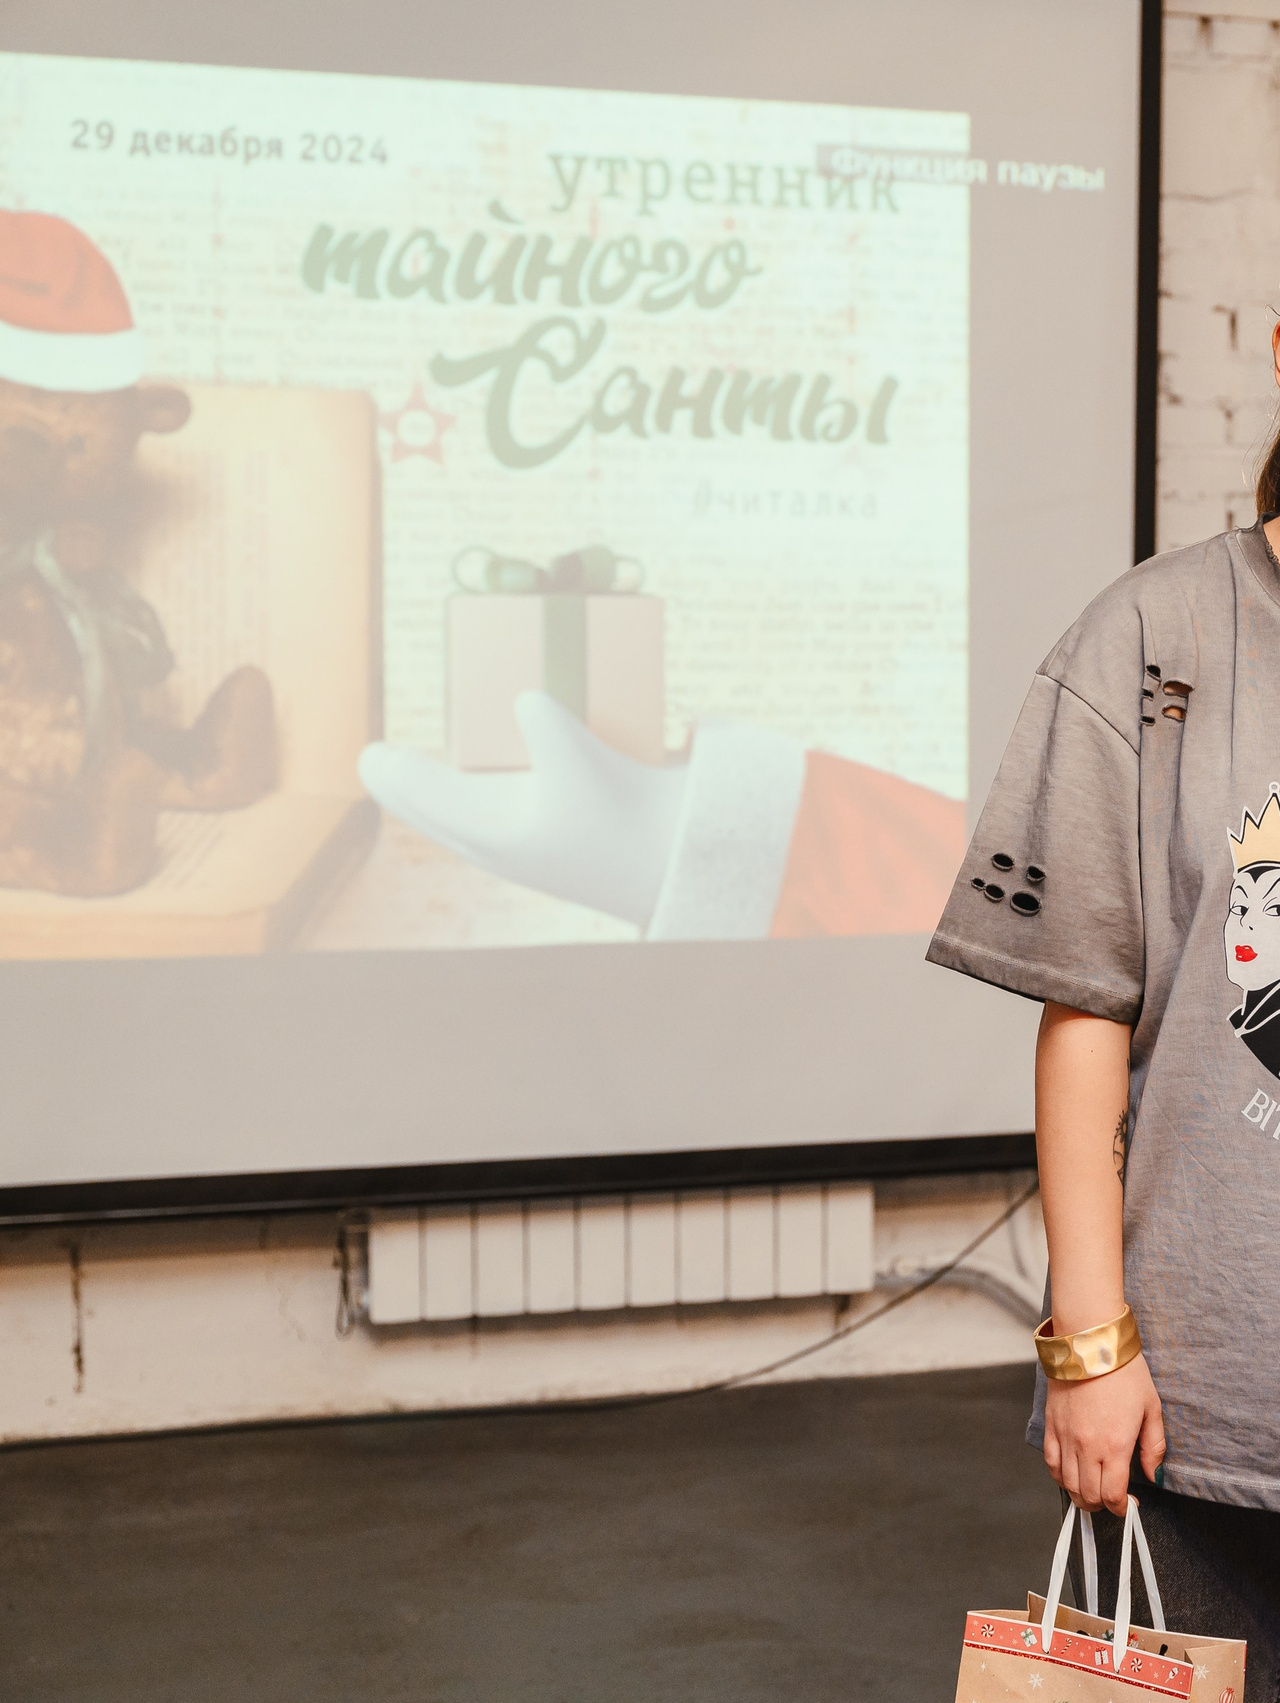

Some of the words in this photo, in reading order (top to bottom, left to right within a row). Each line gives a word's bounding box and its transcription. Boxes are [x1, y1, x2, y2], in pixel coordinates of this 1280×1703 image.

[70, 119, 115, 151] 29
[129, 124, 284, 165] декабря
[299, 133, 389, 165] 2024
[998, 162, 1106, 191] паузы
[301, 199, 763, 314] тайного
[429, 315, 900, 470] Санты
